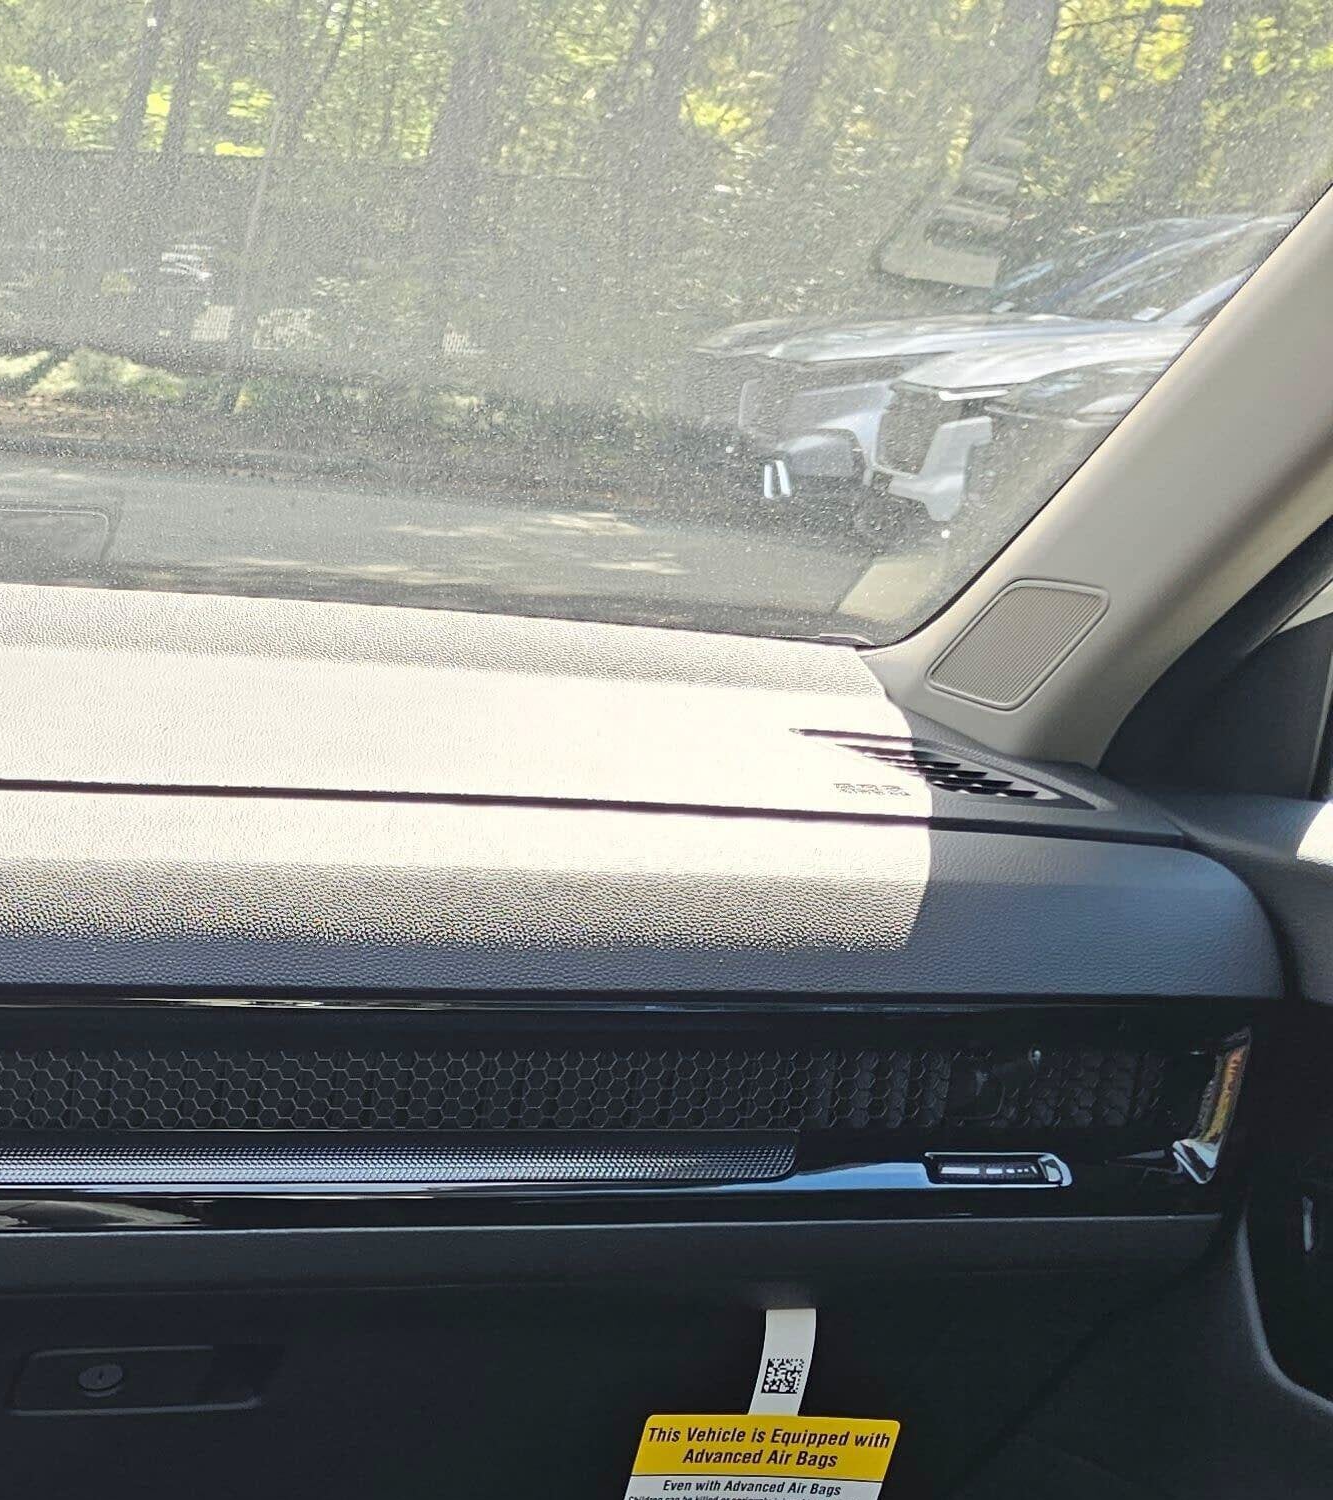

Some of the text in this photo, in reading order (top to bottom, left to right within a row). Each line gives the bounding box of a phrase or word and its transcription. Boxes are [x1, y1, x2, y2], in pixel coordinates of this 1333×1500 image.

[648, 1427, 891, 1449] This Vehicle is Equipped with
[682, 1448, 839, 1470] Advanced Air Bags
[662, 1479, 842, 1498] Even with Advanced Air Bags
